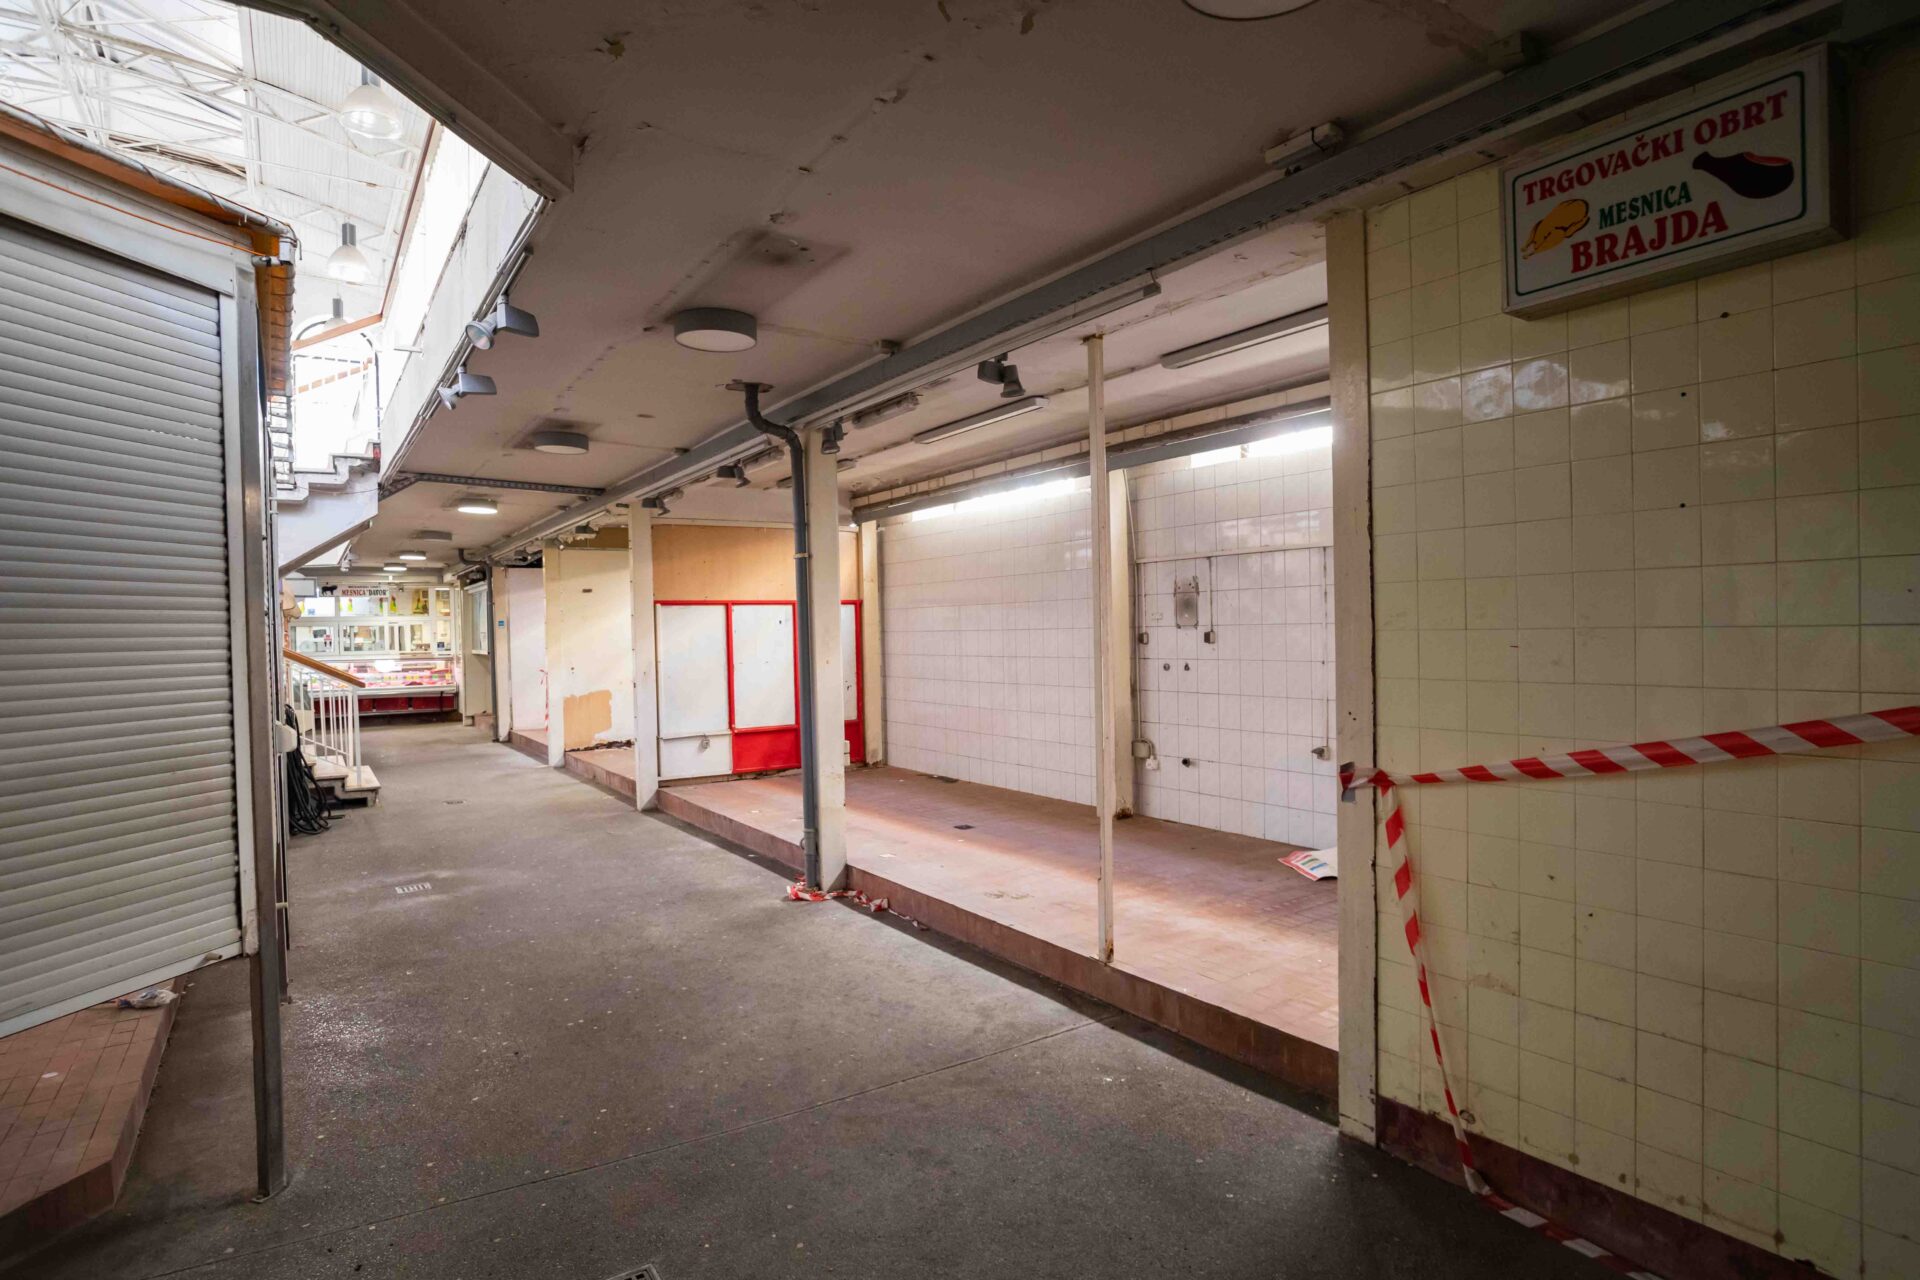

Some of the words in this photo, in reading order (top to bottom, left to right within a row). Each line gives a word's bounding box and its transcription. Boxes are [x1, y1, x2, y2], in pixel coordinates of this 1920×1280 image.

[1523, 129, 1685, 206] TRGOVAČKI
[1693, 90, 1788, 145] OBRT
[1570, 201, 1729, 274] BRAJDA
[1598, 181, 1692, 230] MESNICA
